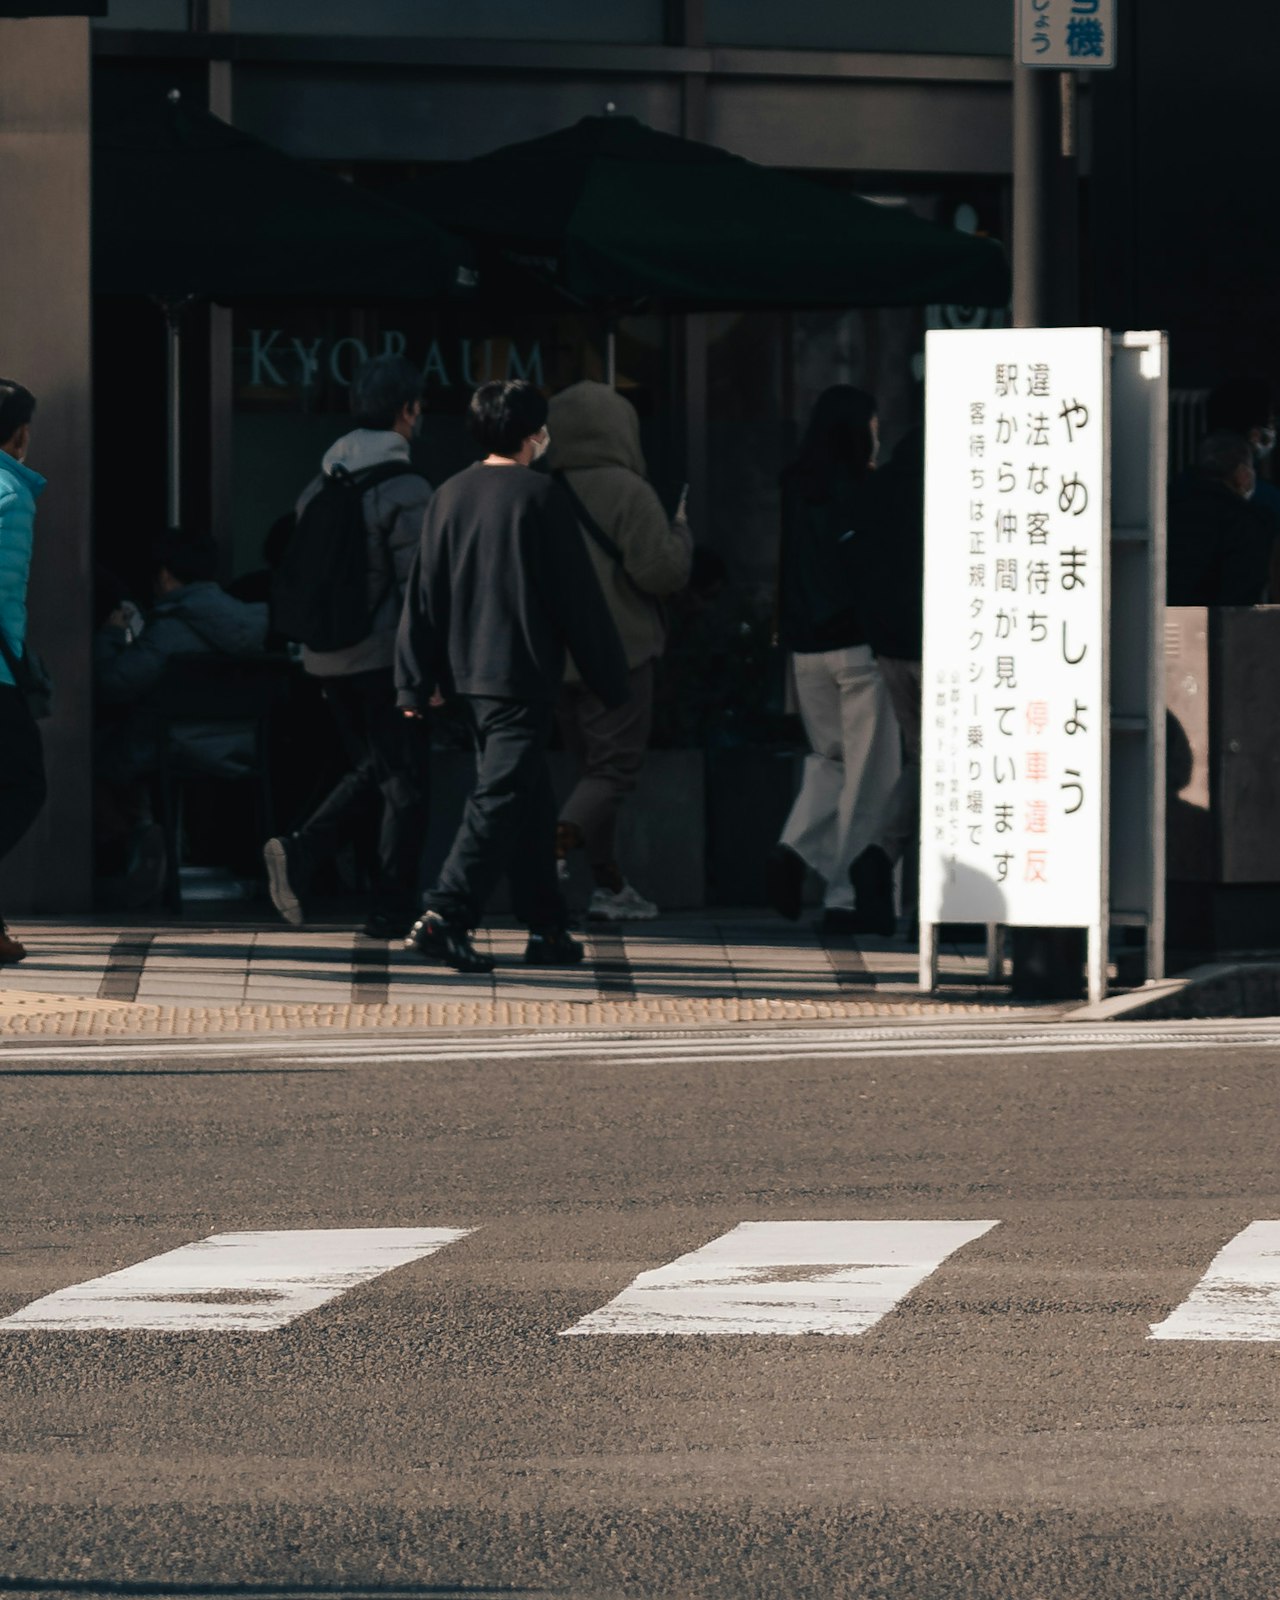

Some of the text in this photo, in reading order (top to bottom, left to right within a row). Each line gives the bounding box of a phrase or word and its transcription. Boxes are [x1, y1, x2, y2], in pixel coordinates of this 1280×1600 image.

[993, 363, 1019, 883] 駅から仲間が見ています
[1025, 363, 1051, 883] 違法な客待ち 停車違反
[1058, 397, 1090, 815] やめましょう
